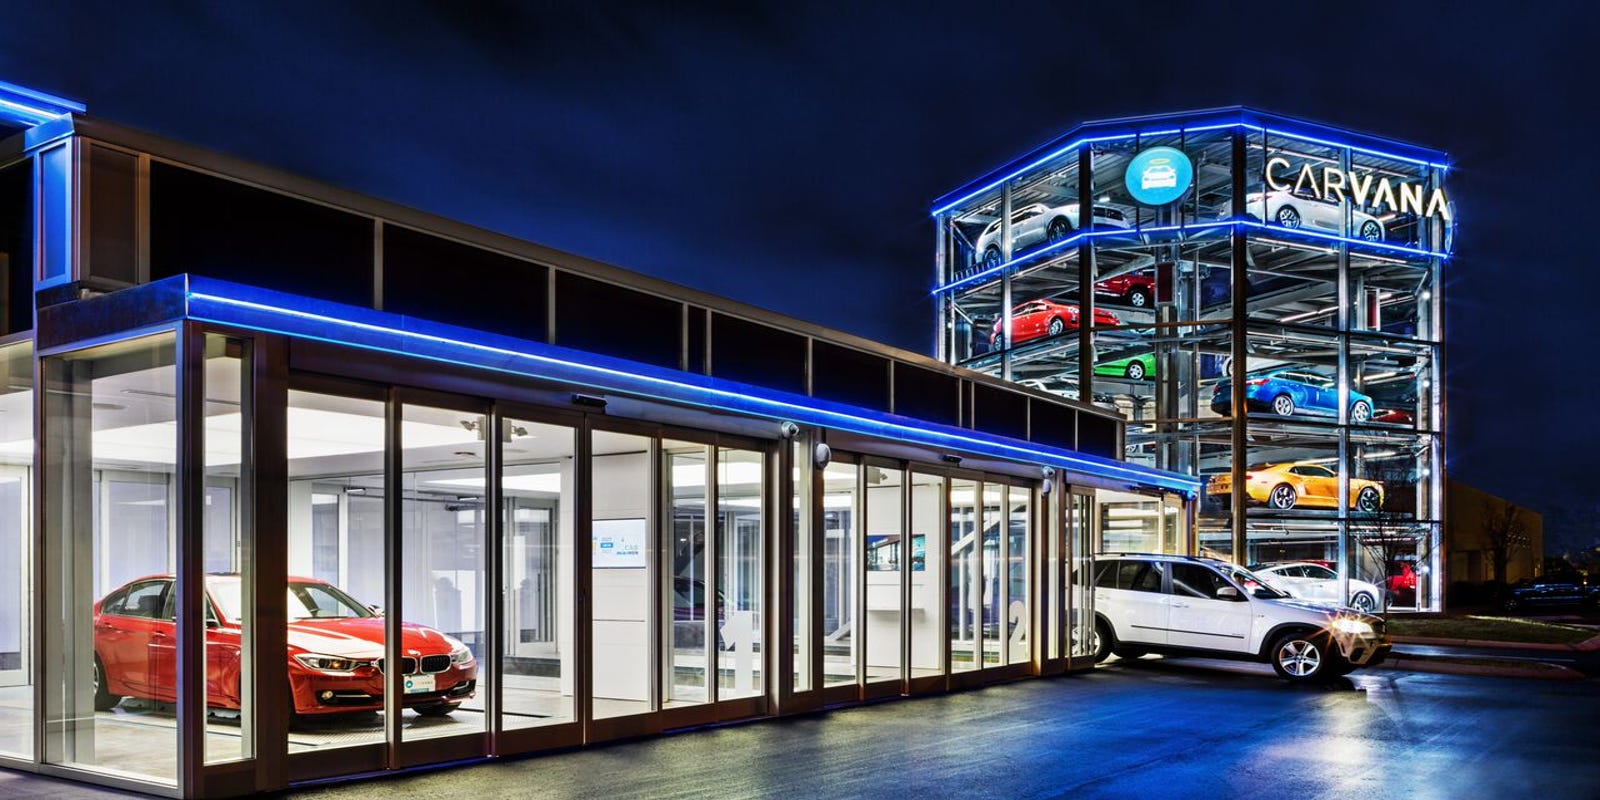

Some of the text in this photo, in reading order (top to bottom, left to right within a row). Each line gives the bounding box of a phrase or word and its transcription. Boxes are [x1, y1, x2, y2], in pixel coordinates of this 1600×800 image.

[1265, 157, 1450, 220] CARVANA
[721, 610, 753, 696] 1
[1009, 601, 1027, 661] 2
